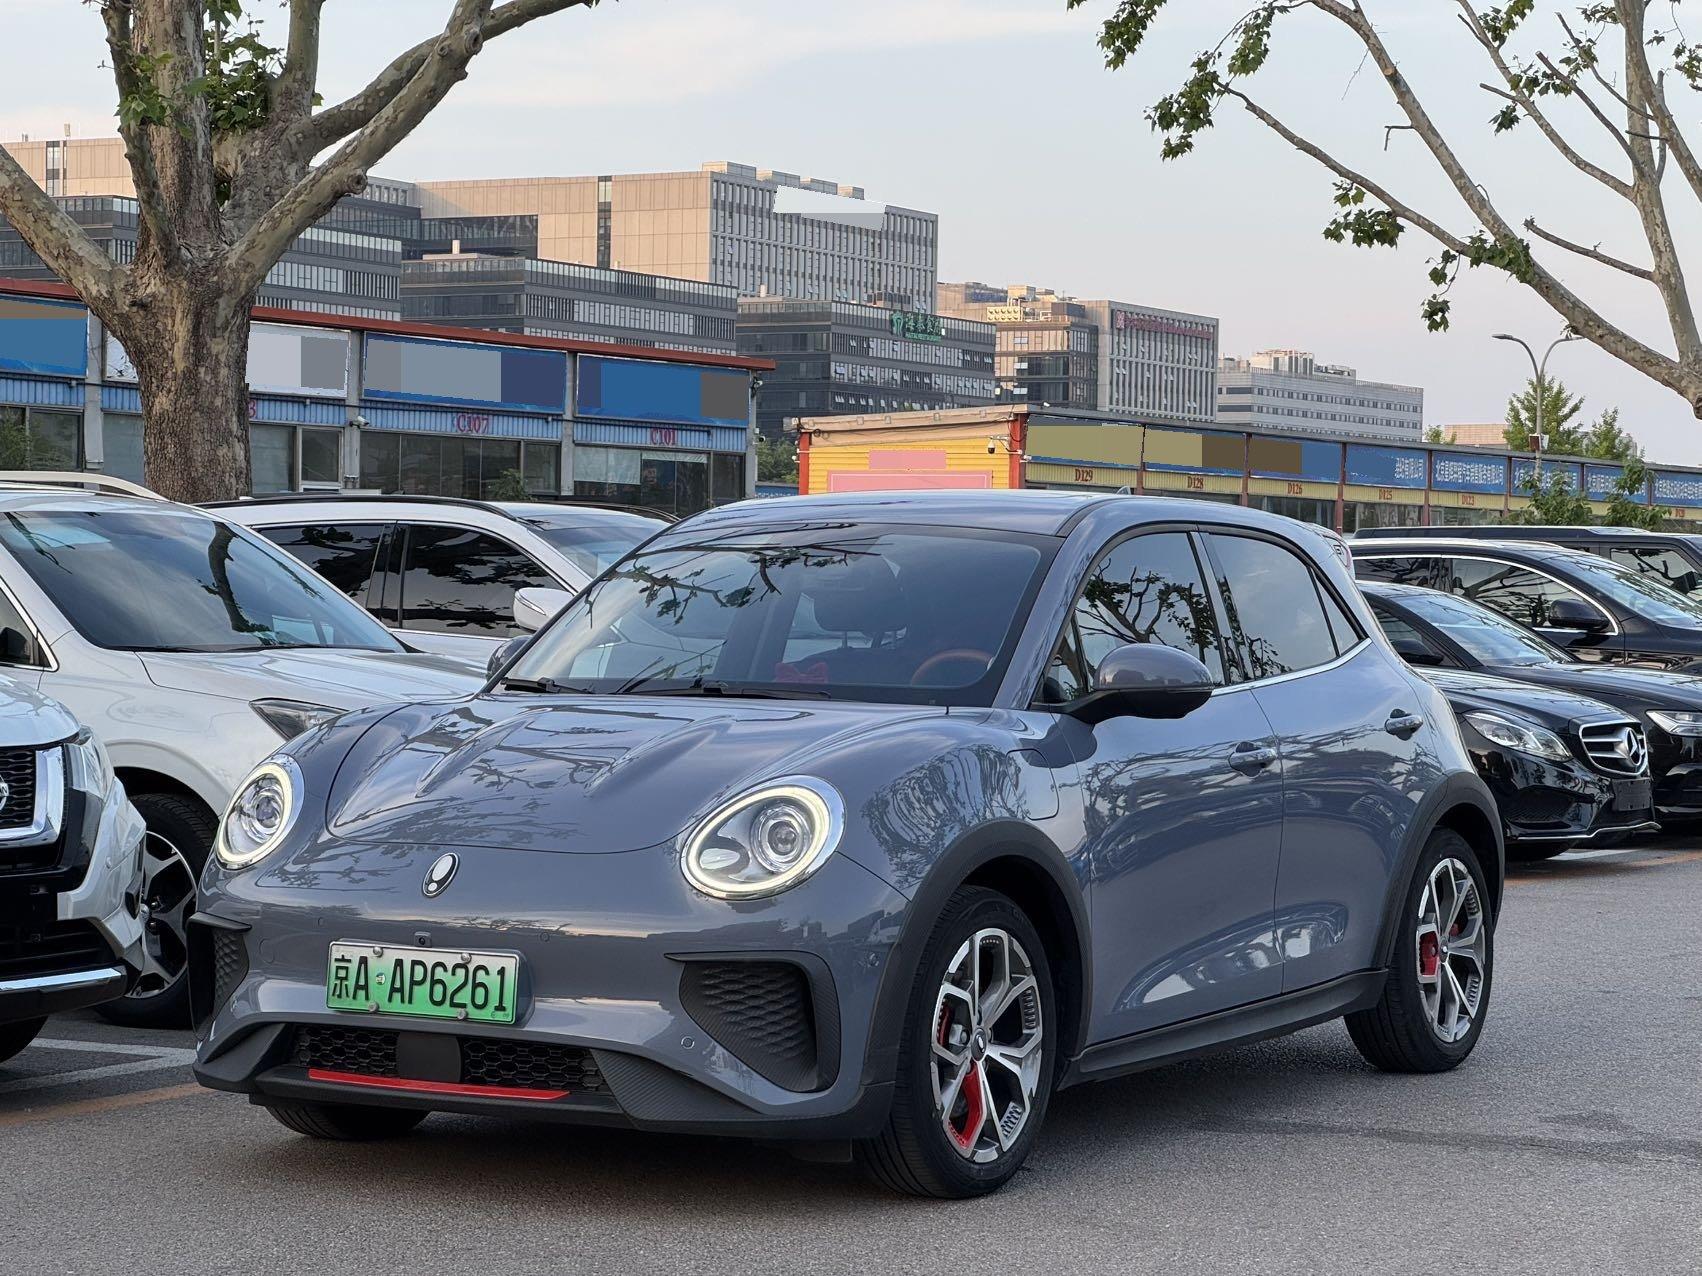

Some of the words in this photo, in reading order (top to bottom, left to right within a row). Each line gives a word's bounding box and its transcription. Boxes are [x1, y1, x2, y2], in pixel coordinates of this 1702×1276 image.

[650, 428, 677, 446] C101
[1074, 468, 1094, 482] D129
[1187, 476, 1204, 489] D128
